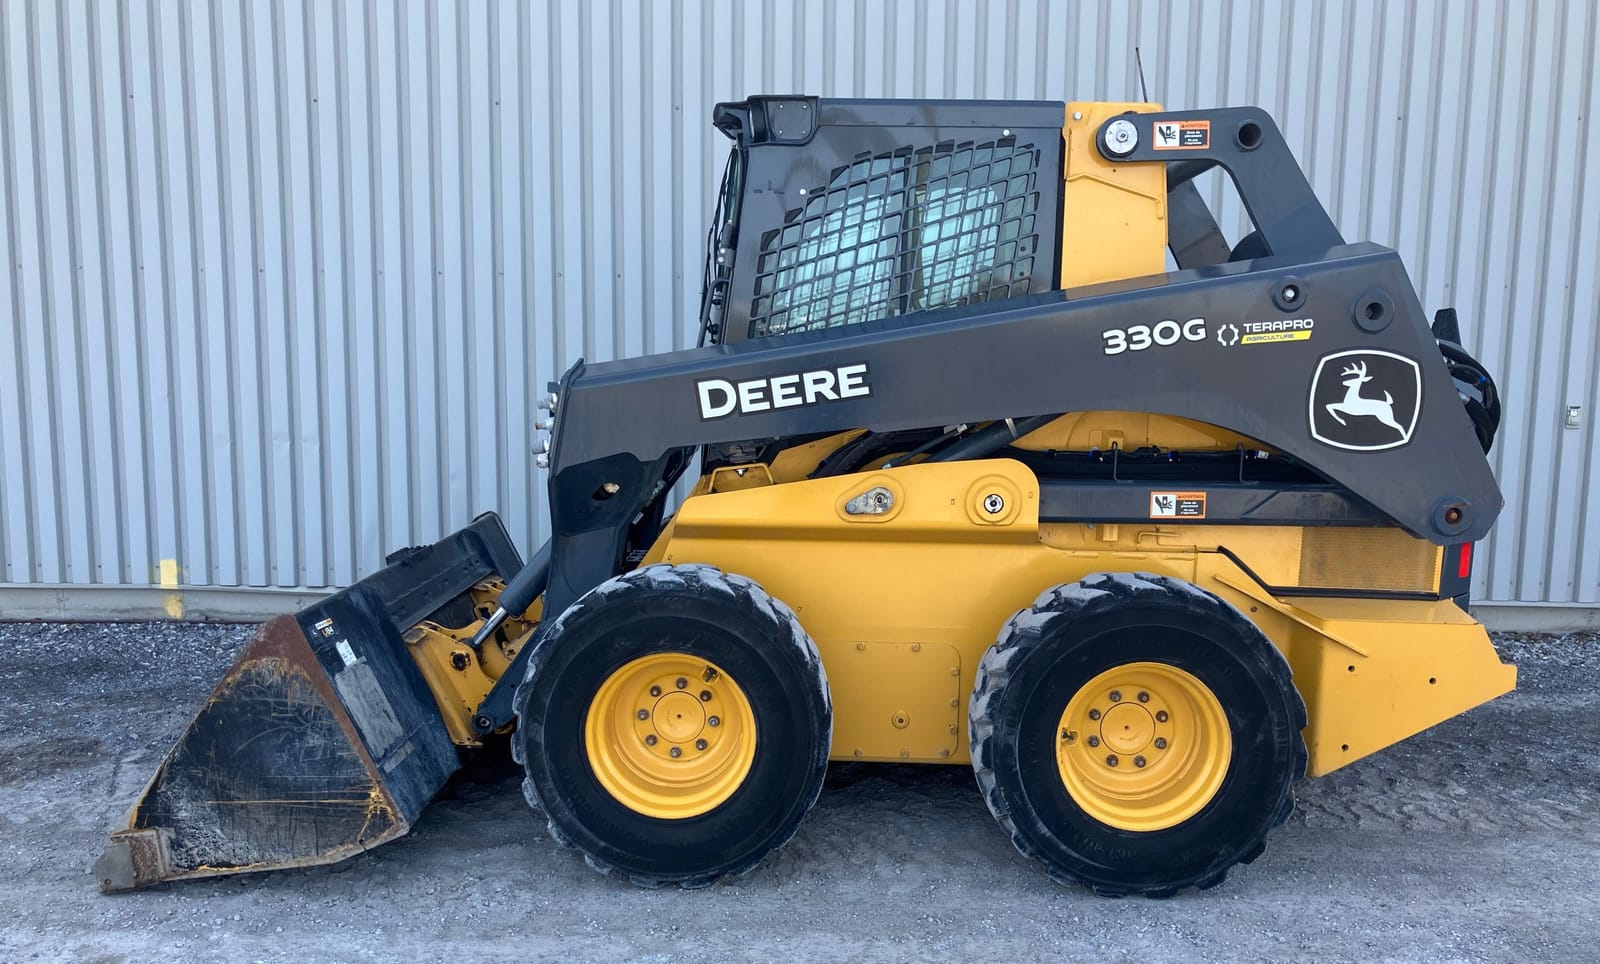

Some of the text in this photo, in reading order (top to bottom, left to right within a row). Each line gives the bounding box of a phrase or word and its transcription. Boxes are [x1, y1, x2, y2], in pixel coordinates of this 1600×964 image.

[1102, 318, 1207, 355] 330G
[1243, 318, 1315, 333] TERAPRO
[1246, 333, 1294, 342] AGRICULTURE
[697, 364, 870, 419] DEERE
